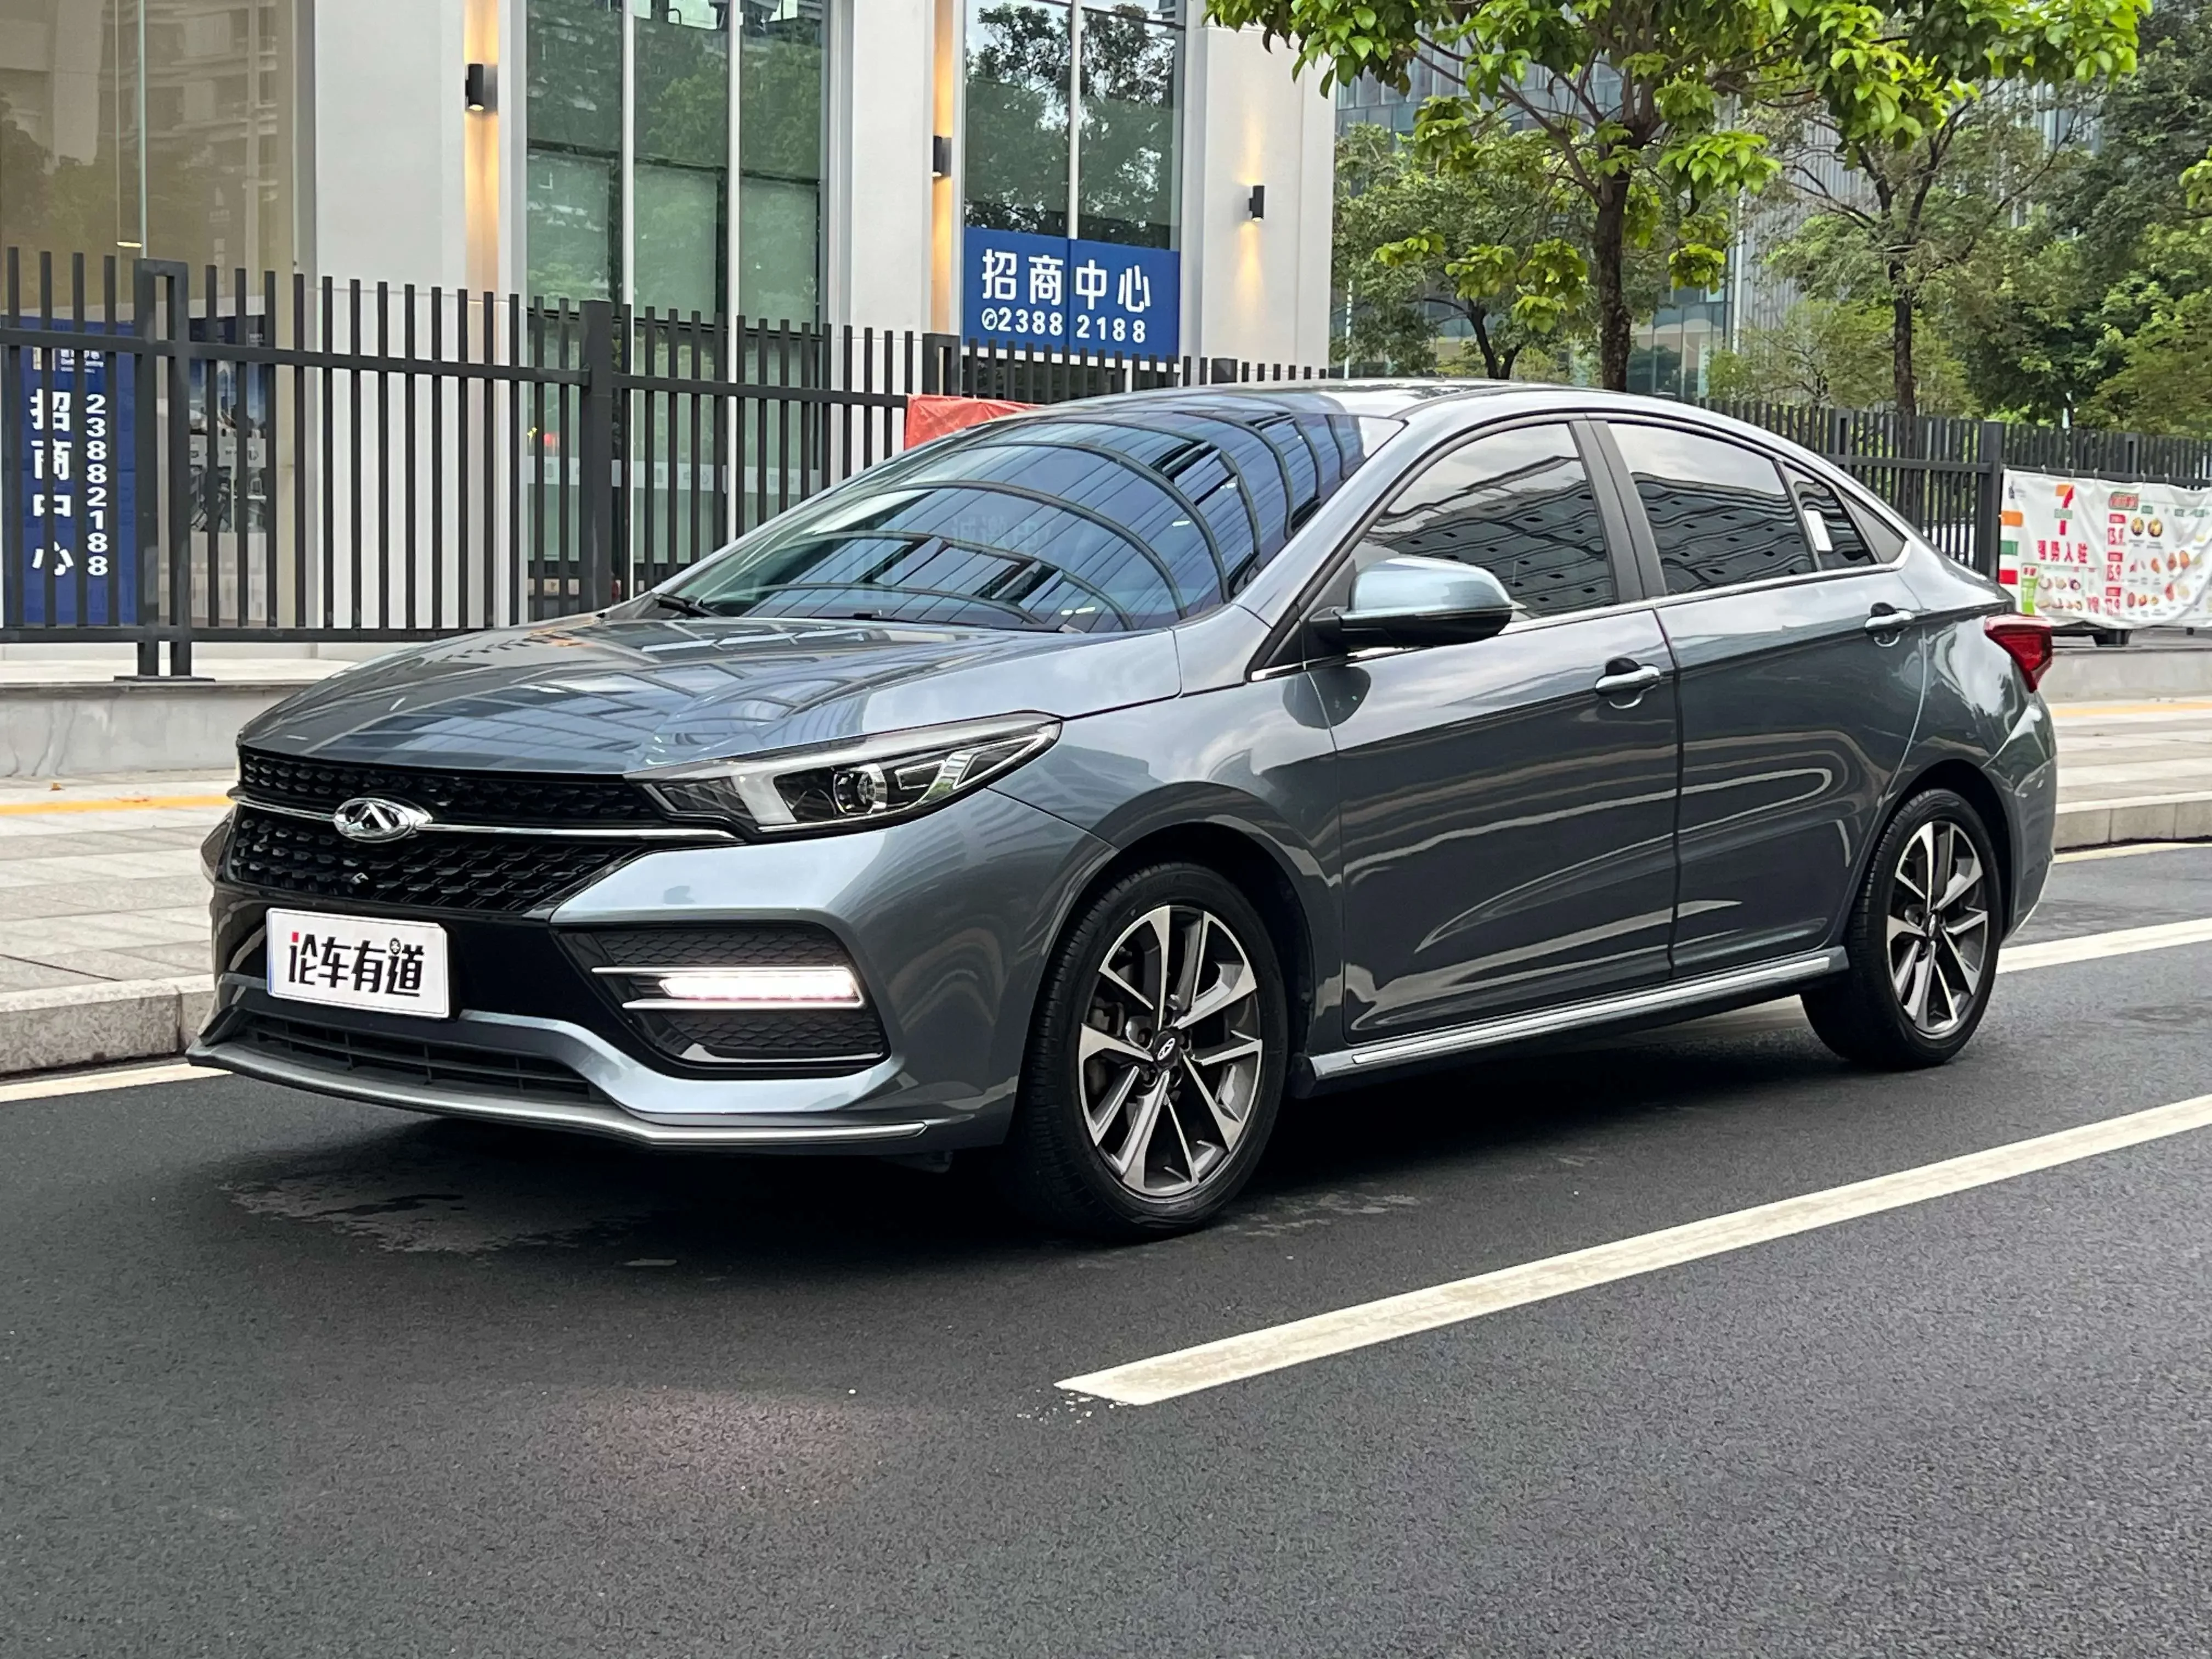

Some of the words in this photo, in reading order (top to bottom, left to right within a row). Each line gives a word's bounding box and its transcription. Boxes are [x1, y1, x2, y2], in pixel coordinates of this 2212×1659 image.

[982, 249, 1150, 313] 招商中心
[998, 307, 1063, 336] 2388
[1076, 315, 1146, 343] 2188
[86, 394, 108, 576] 23882188
[288, 931, 425, 997] 论车有道
